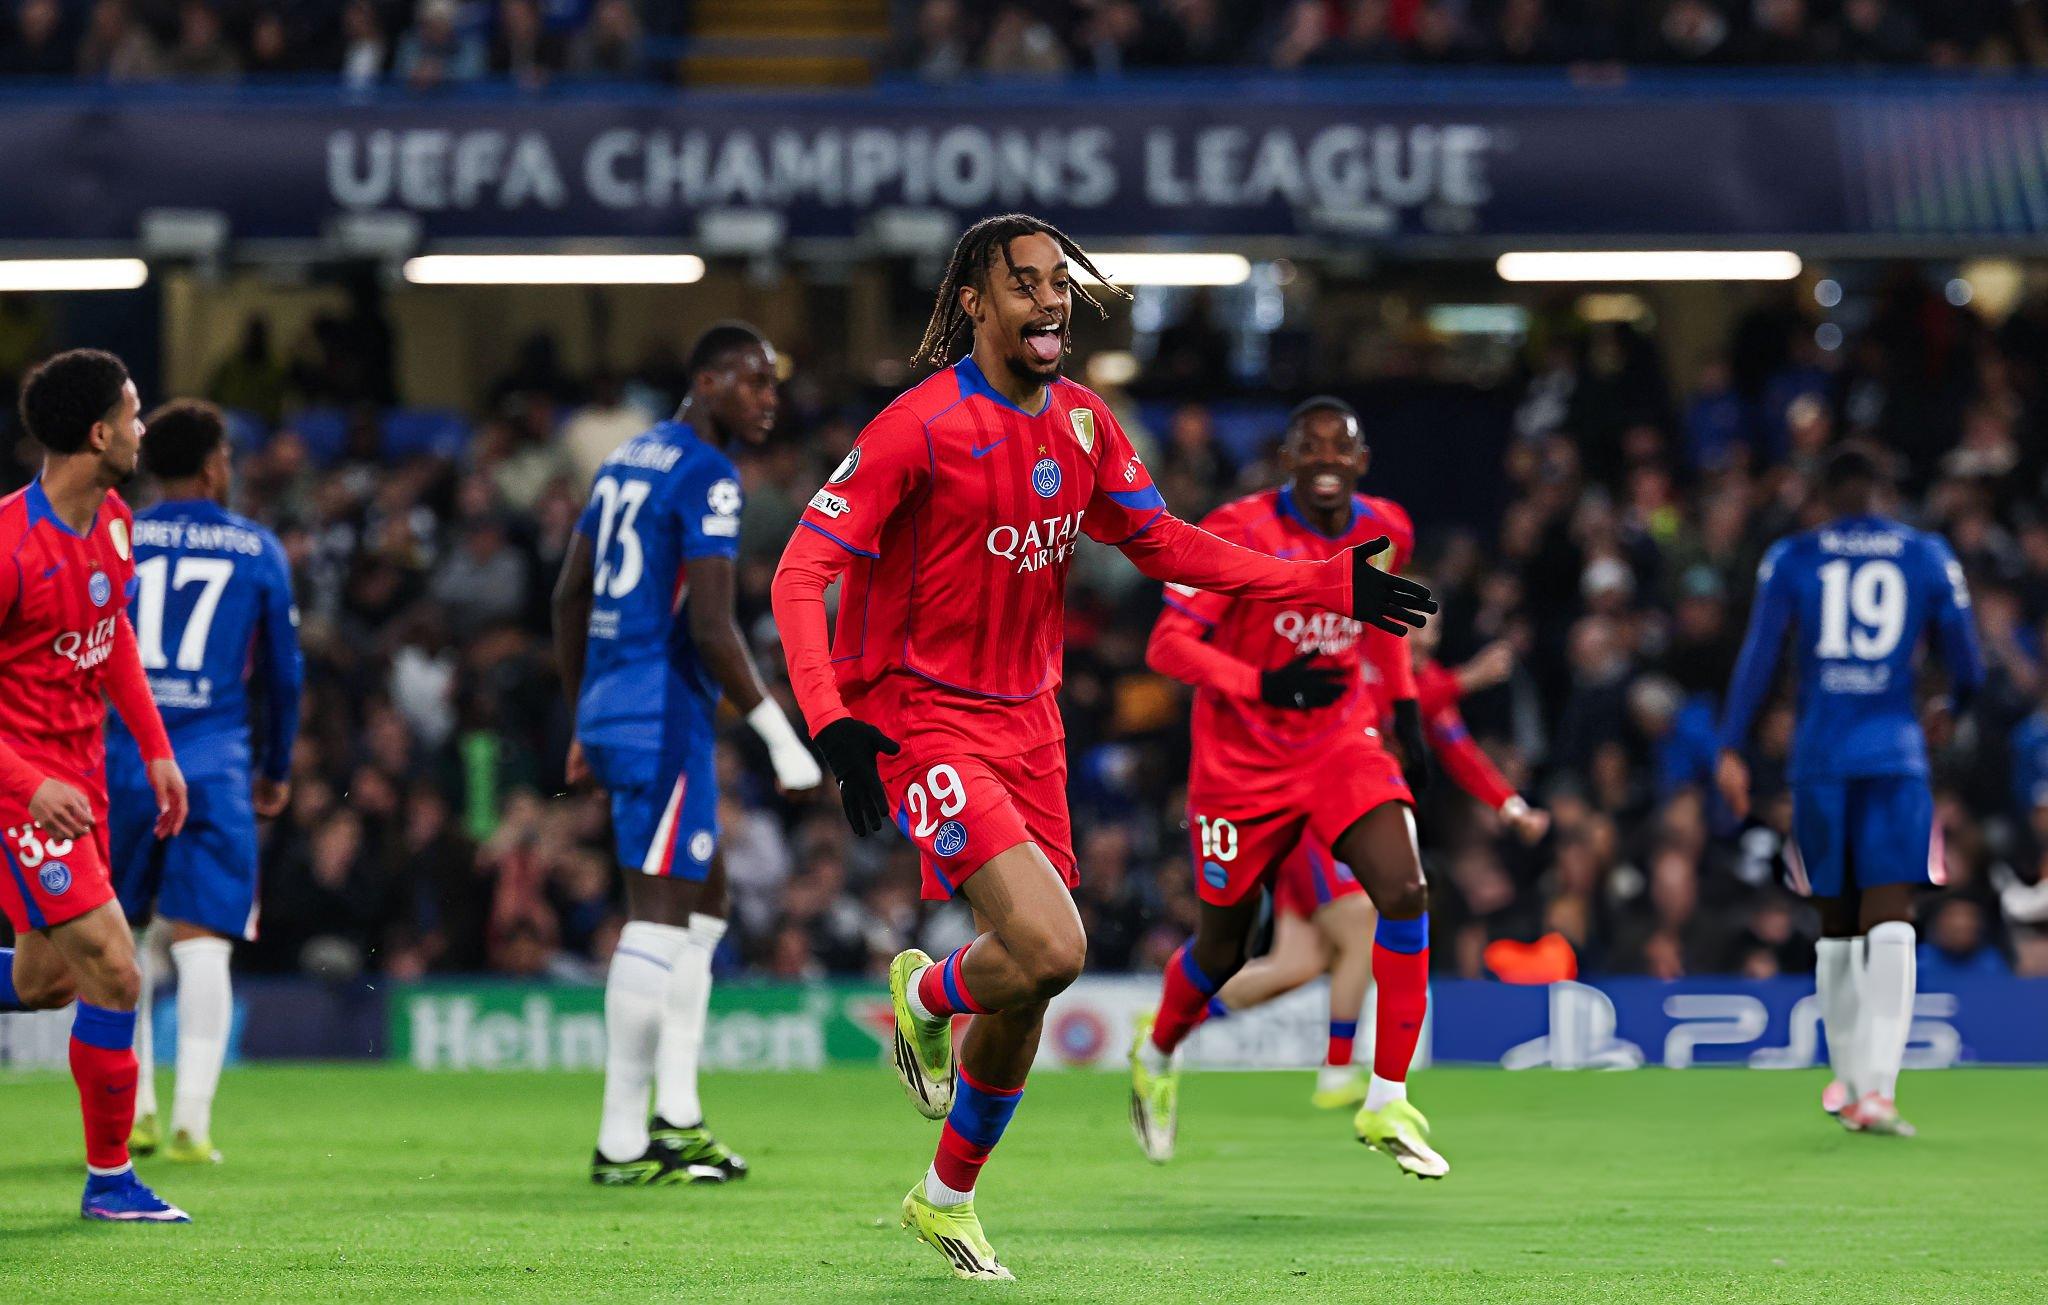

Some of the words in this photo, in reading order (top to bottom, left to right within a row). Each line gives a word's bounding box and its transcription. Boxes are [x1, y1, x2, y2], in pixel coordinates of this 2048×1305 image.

[327, 129, 566, 210] UEFA
[584, 126, 1116, 210] CHAMPIONS
[1144, 124, 1495, 208] LEAGUE
[1036, 461, 1055, 472] PARIS
[590, 475, 652, 599] 23
[54, 614, 117, 662] QATA
[136, 554, 235, 672] 17
[1815, 558, 1908, 662] 19
[906, 763, 967, 838] 29
[1195, 813, 1238, 862] 10
[410, 995, 826, 1071] Heinen
